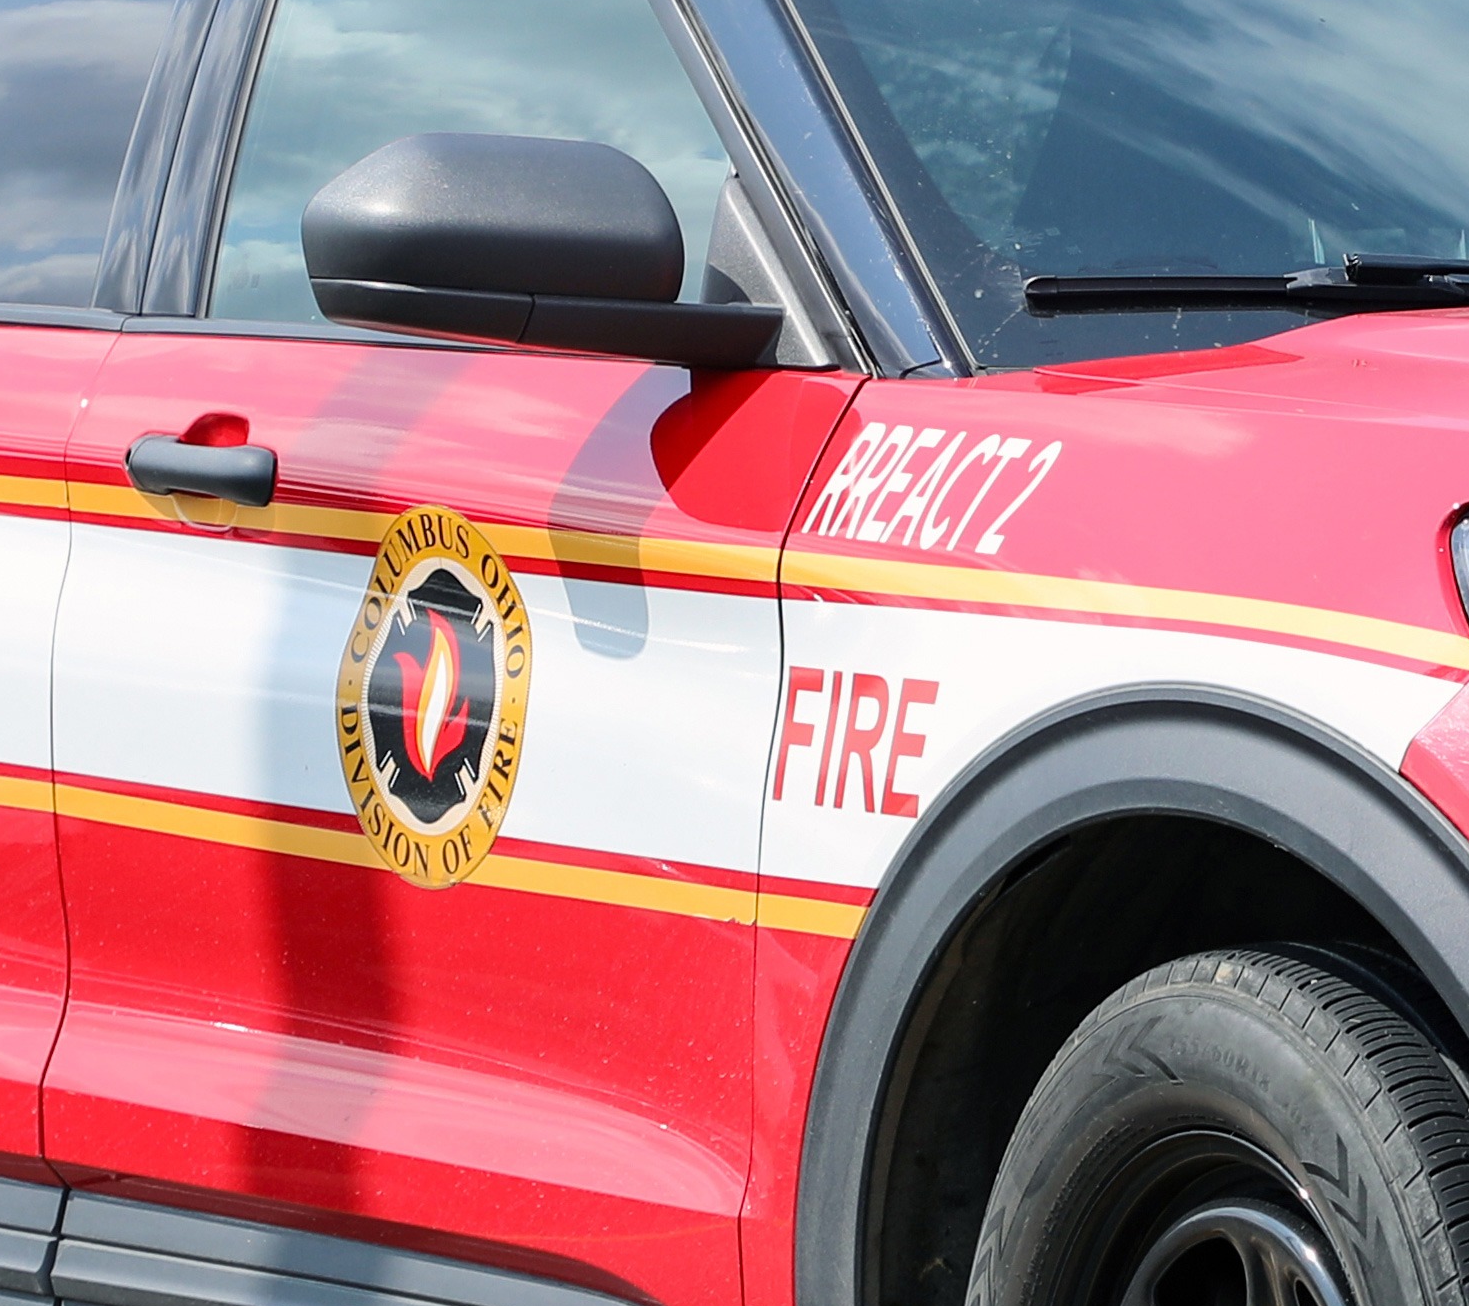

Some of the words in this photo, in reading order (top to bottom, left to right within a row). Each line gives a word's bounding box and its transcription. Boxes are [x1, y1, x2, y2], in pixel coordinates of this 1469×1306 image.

[802, 421, 1033, 552] RREACT
[975, 440, 1063, 556] 2
[350, 513, 470, 665] COLUMBUS
[480, 553, 526, 680] OHIO
[340, 702, 431, 877] DIVISION
[442, 826, 474, 876] OF
[476, 719, 519, 827] FIRE
[772, 666, 940, 818] FIRE
